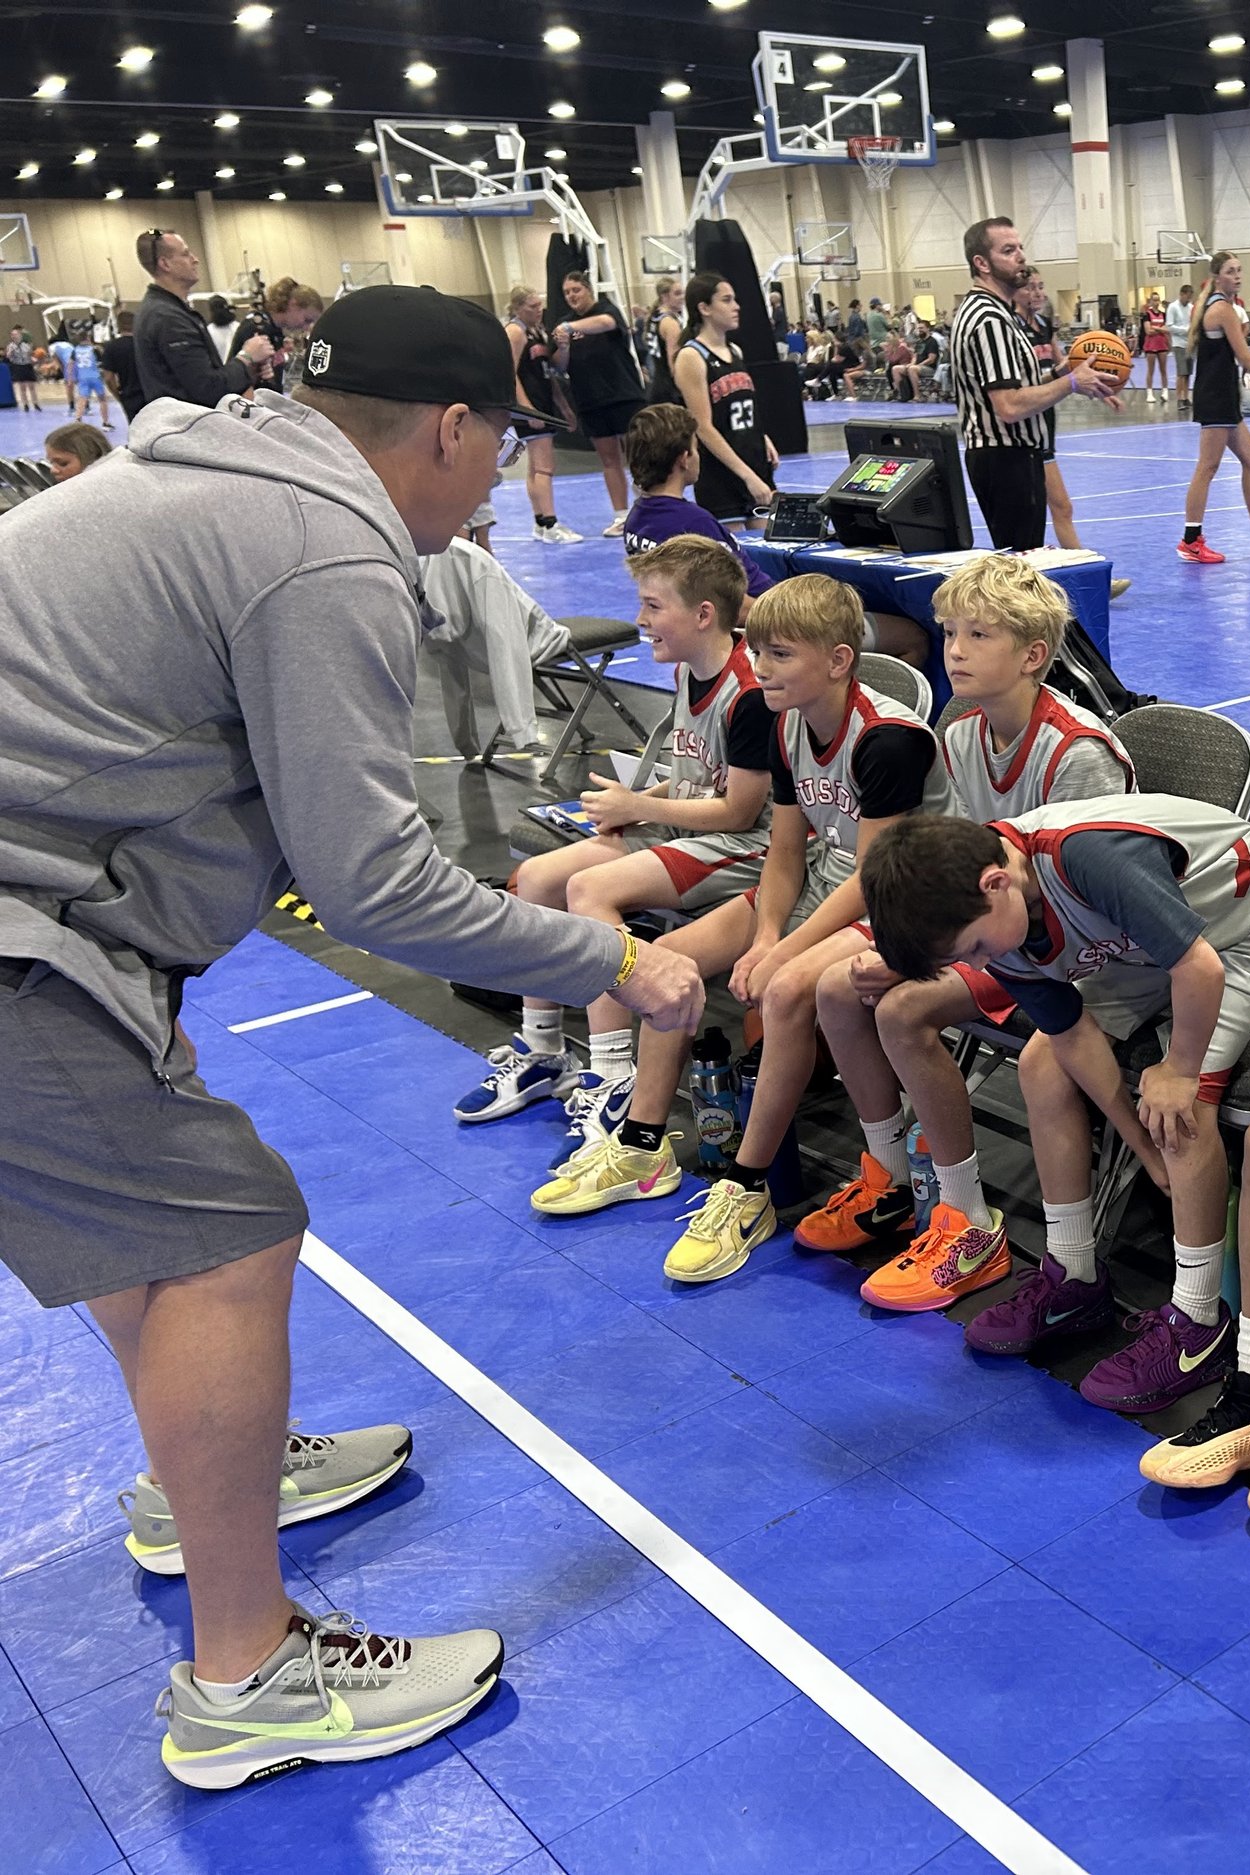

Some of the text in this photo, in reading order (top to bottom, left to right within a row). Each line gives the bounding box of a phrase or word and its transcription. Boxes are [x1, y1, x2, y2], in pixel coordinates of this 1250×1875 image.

[778, 61, 787, 77] 4
[1083, 342, 1125, 361] Wilson
[730, 399, 754, 430] 23
[253, 1770, 270, 1779] NIKE
[270, 1764, 289, 1773] TRAIL
